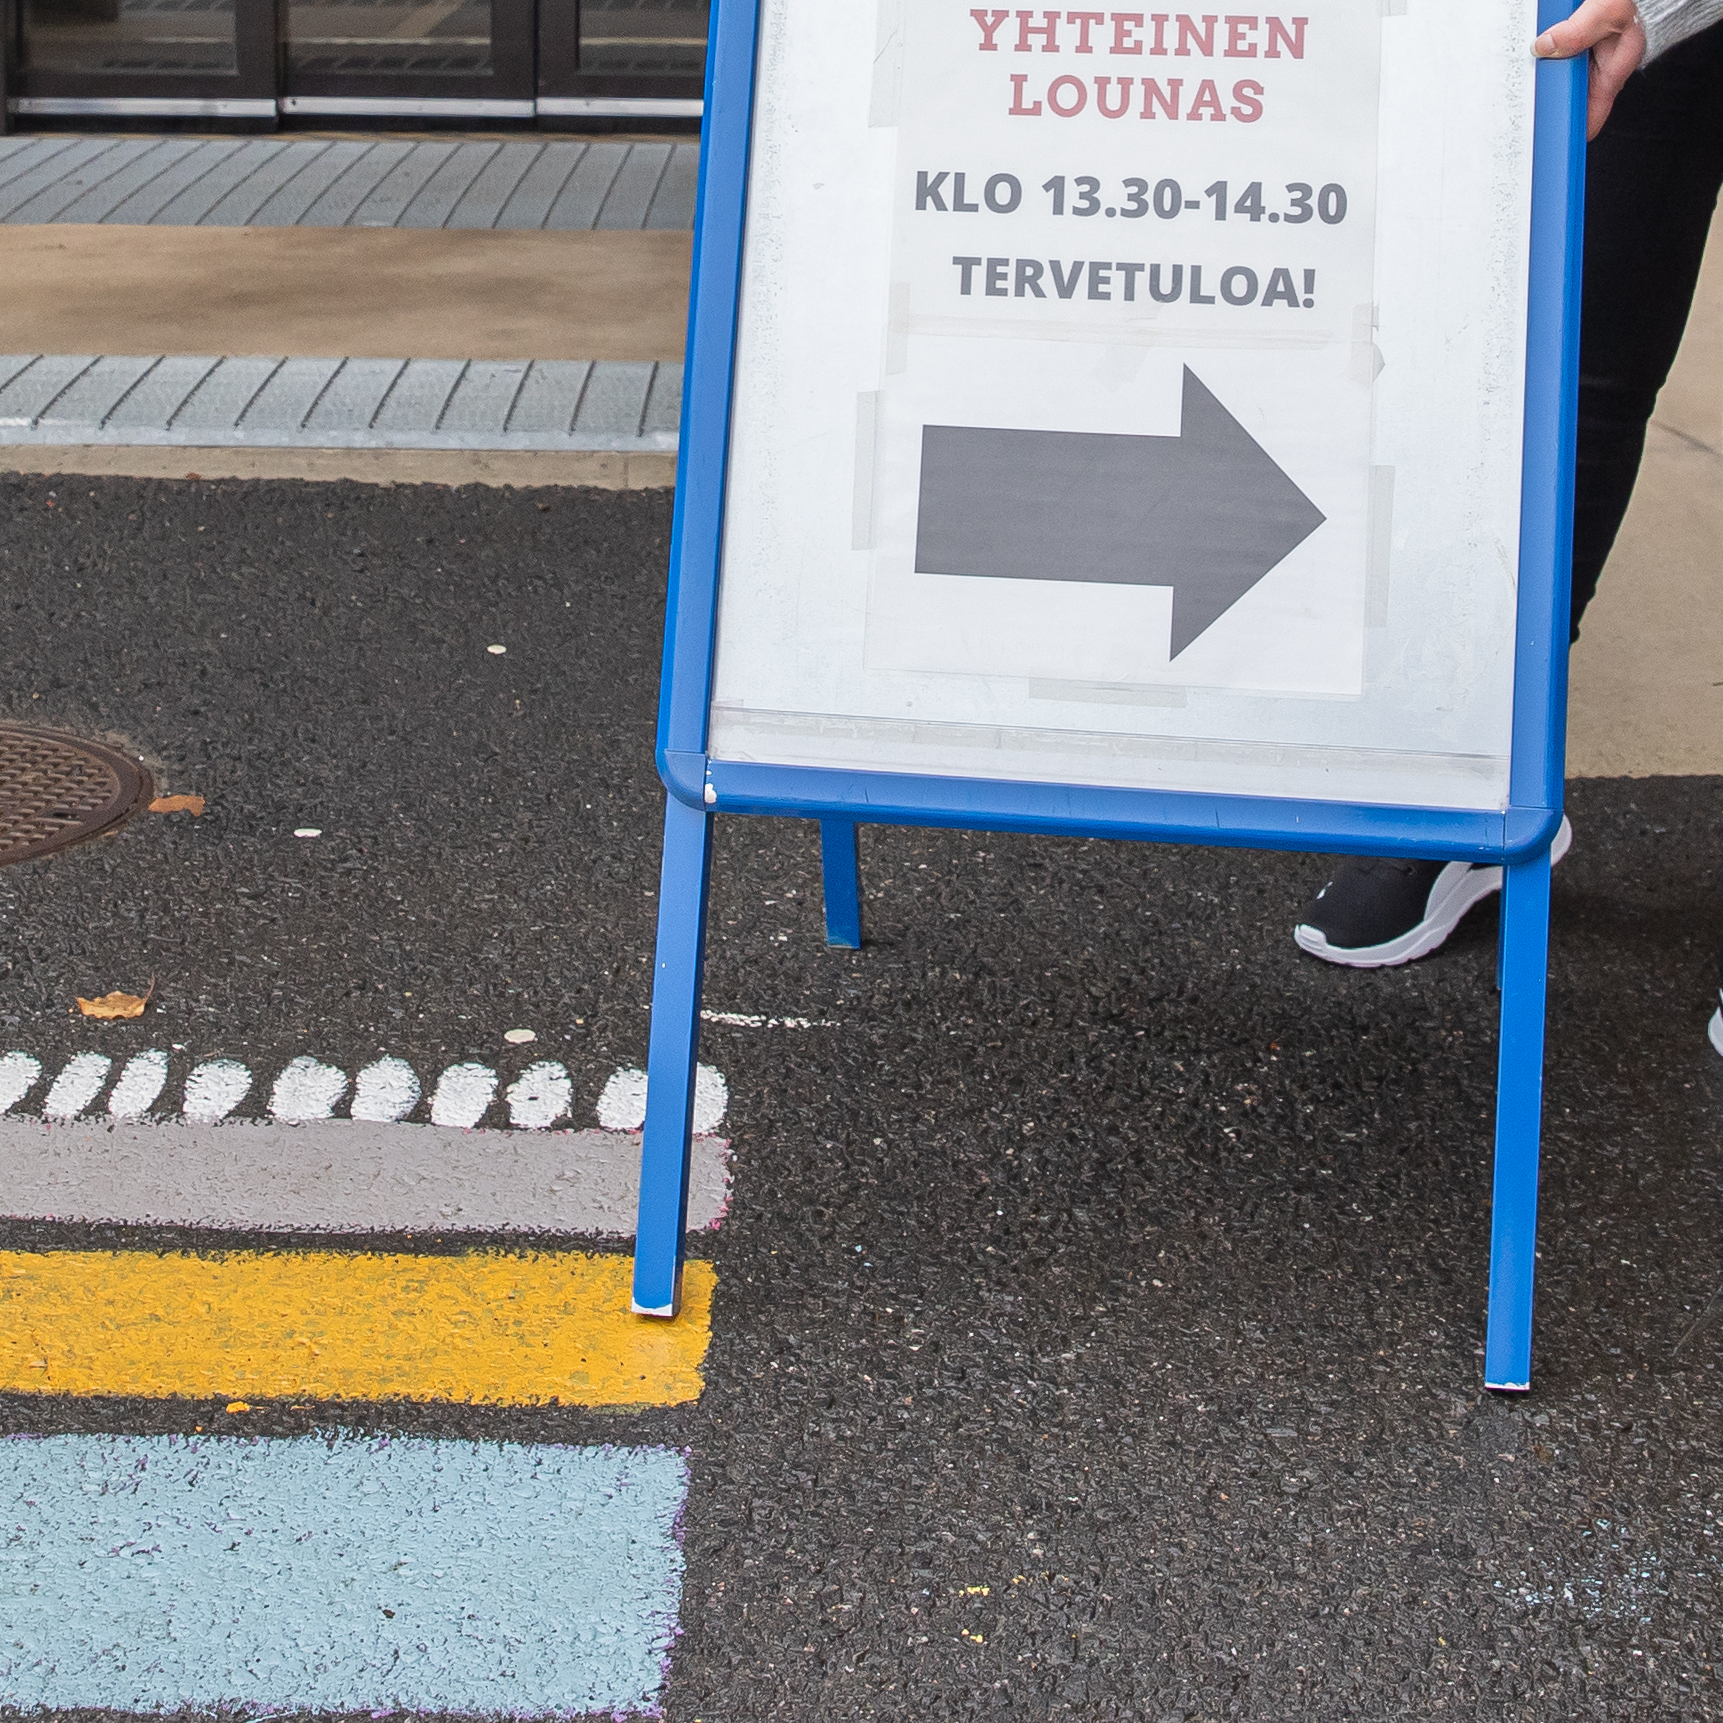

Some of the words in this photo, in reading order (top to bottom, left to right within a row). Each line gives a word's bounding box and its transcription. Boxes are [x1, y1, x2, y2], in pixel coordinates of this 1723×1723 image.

[969, 8, 1310, 61] YHTEINEN
[1008, 73, 1266, 124] LOUNAS
[914, 170, 1023, 215] KLO
[1041, 174, 1349, 226] 13.30-14.30
[952, 255, 1317, 309] TERVETULOA!
